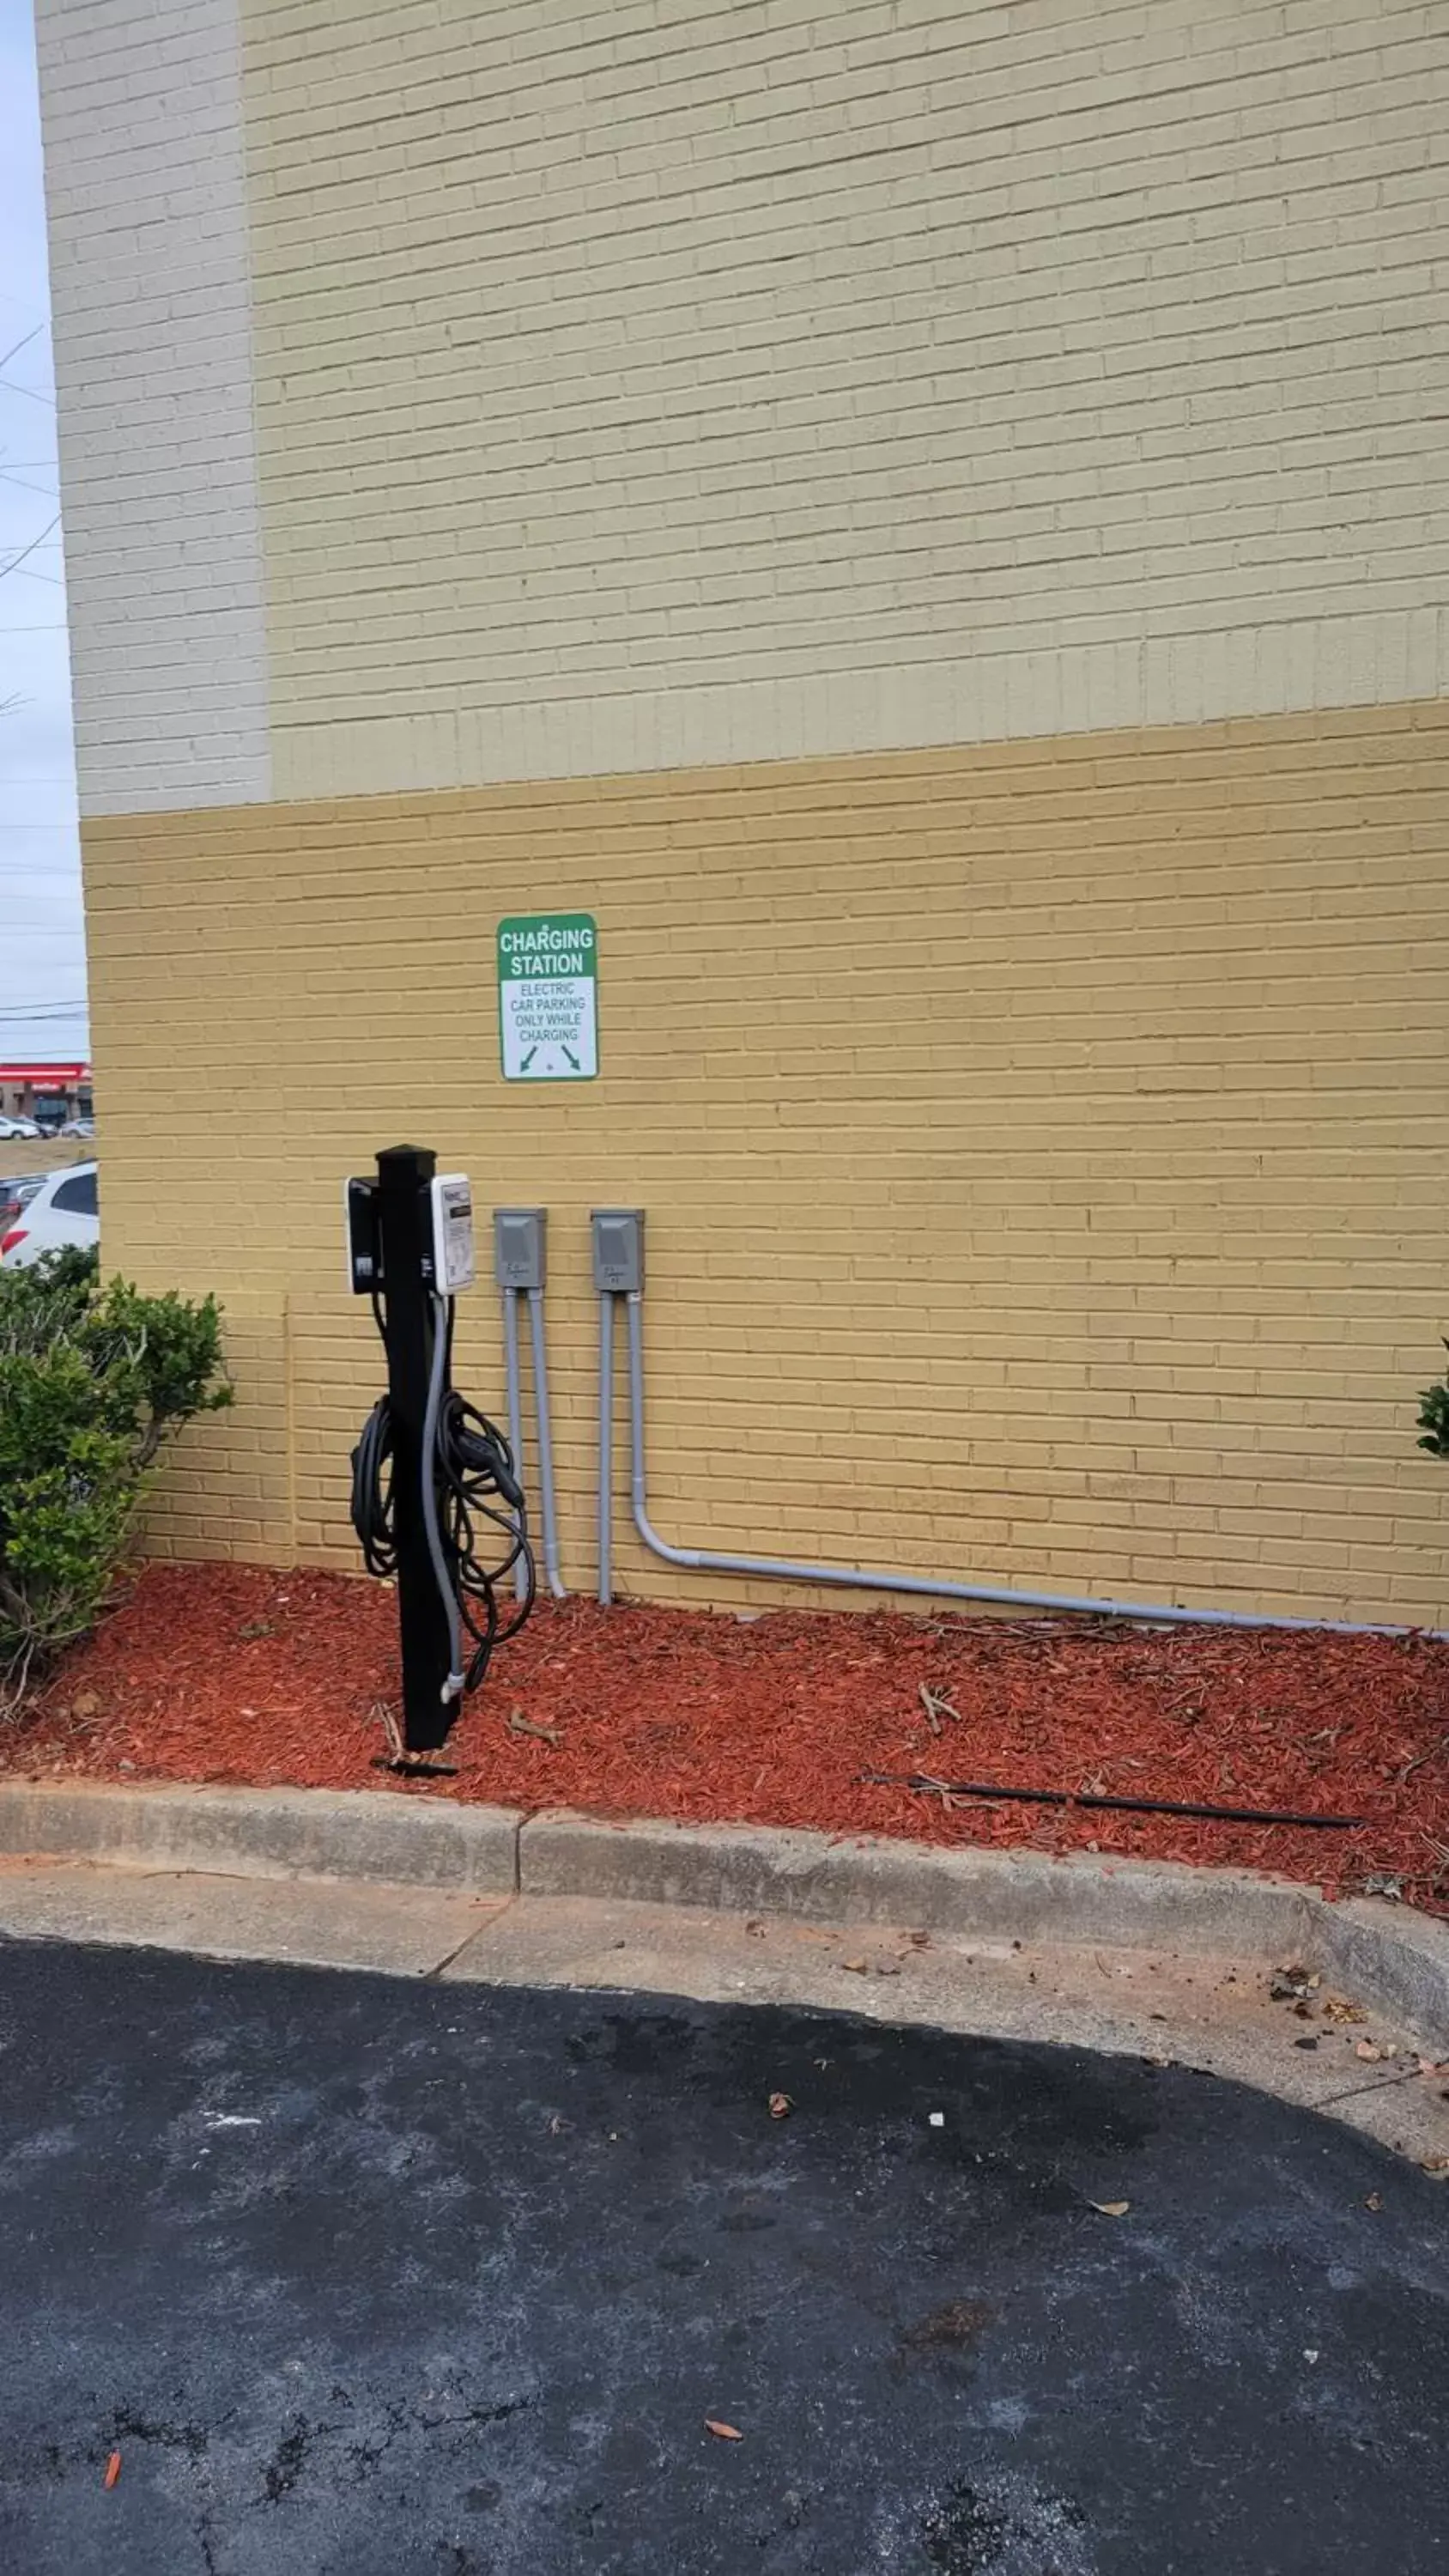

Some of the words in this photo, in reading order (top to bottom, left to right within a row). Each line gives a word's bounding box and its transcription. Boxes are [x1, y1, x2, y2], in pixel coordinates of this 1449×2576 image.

[500, 928, 593, 952] CHARGING
[511, 953, 584, 975] STATION
[520, 983, 574, 996] ELECTRIC
[511, 999, 535, 1012] CAR
[536, 997, 586, 1011] PARKING
[515, 1015, 544, 1028] ONLY
[547, 1012, 581, 1025] WHILE
[519, 1029, 578, 1042] CHARGING
